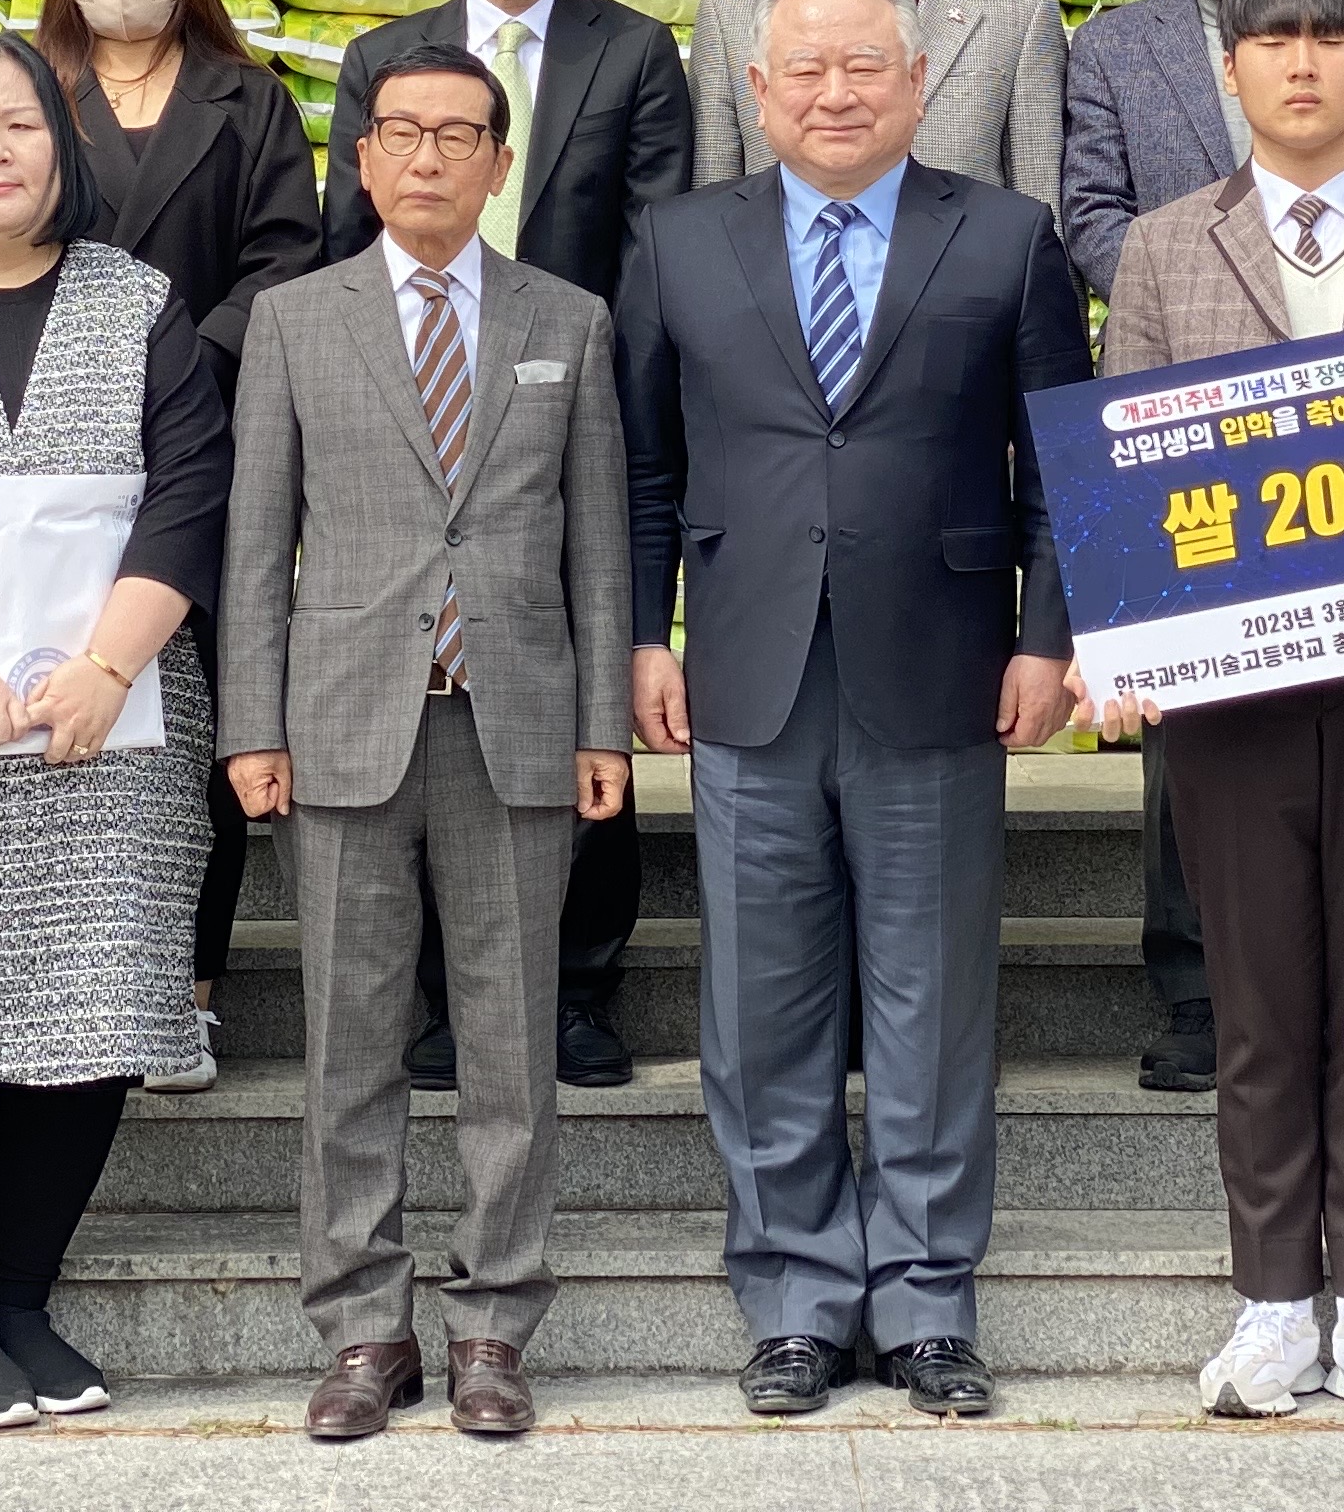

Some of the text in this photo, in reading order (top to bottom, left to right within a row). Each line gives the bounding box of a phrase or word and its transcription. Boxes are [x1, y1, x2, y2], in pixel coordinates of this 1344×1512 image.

[1119, 386, 1224, 426] 개교51주년
[1229, 376, 1287, 402] 기념식
[1291, 370, 1312, 391] 및
[1109, 423, 1215, 469] 신입생의
[1219, 405, 1301, 448] 입학을
[1163, 483, 1237, 569] 쌀
[1241, 604, 1314, 639] 2023년
[1113, 635, 1326, 696] 한국과학기술고등학교
